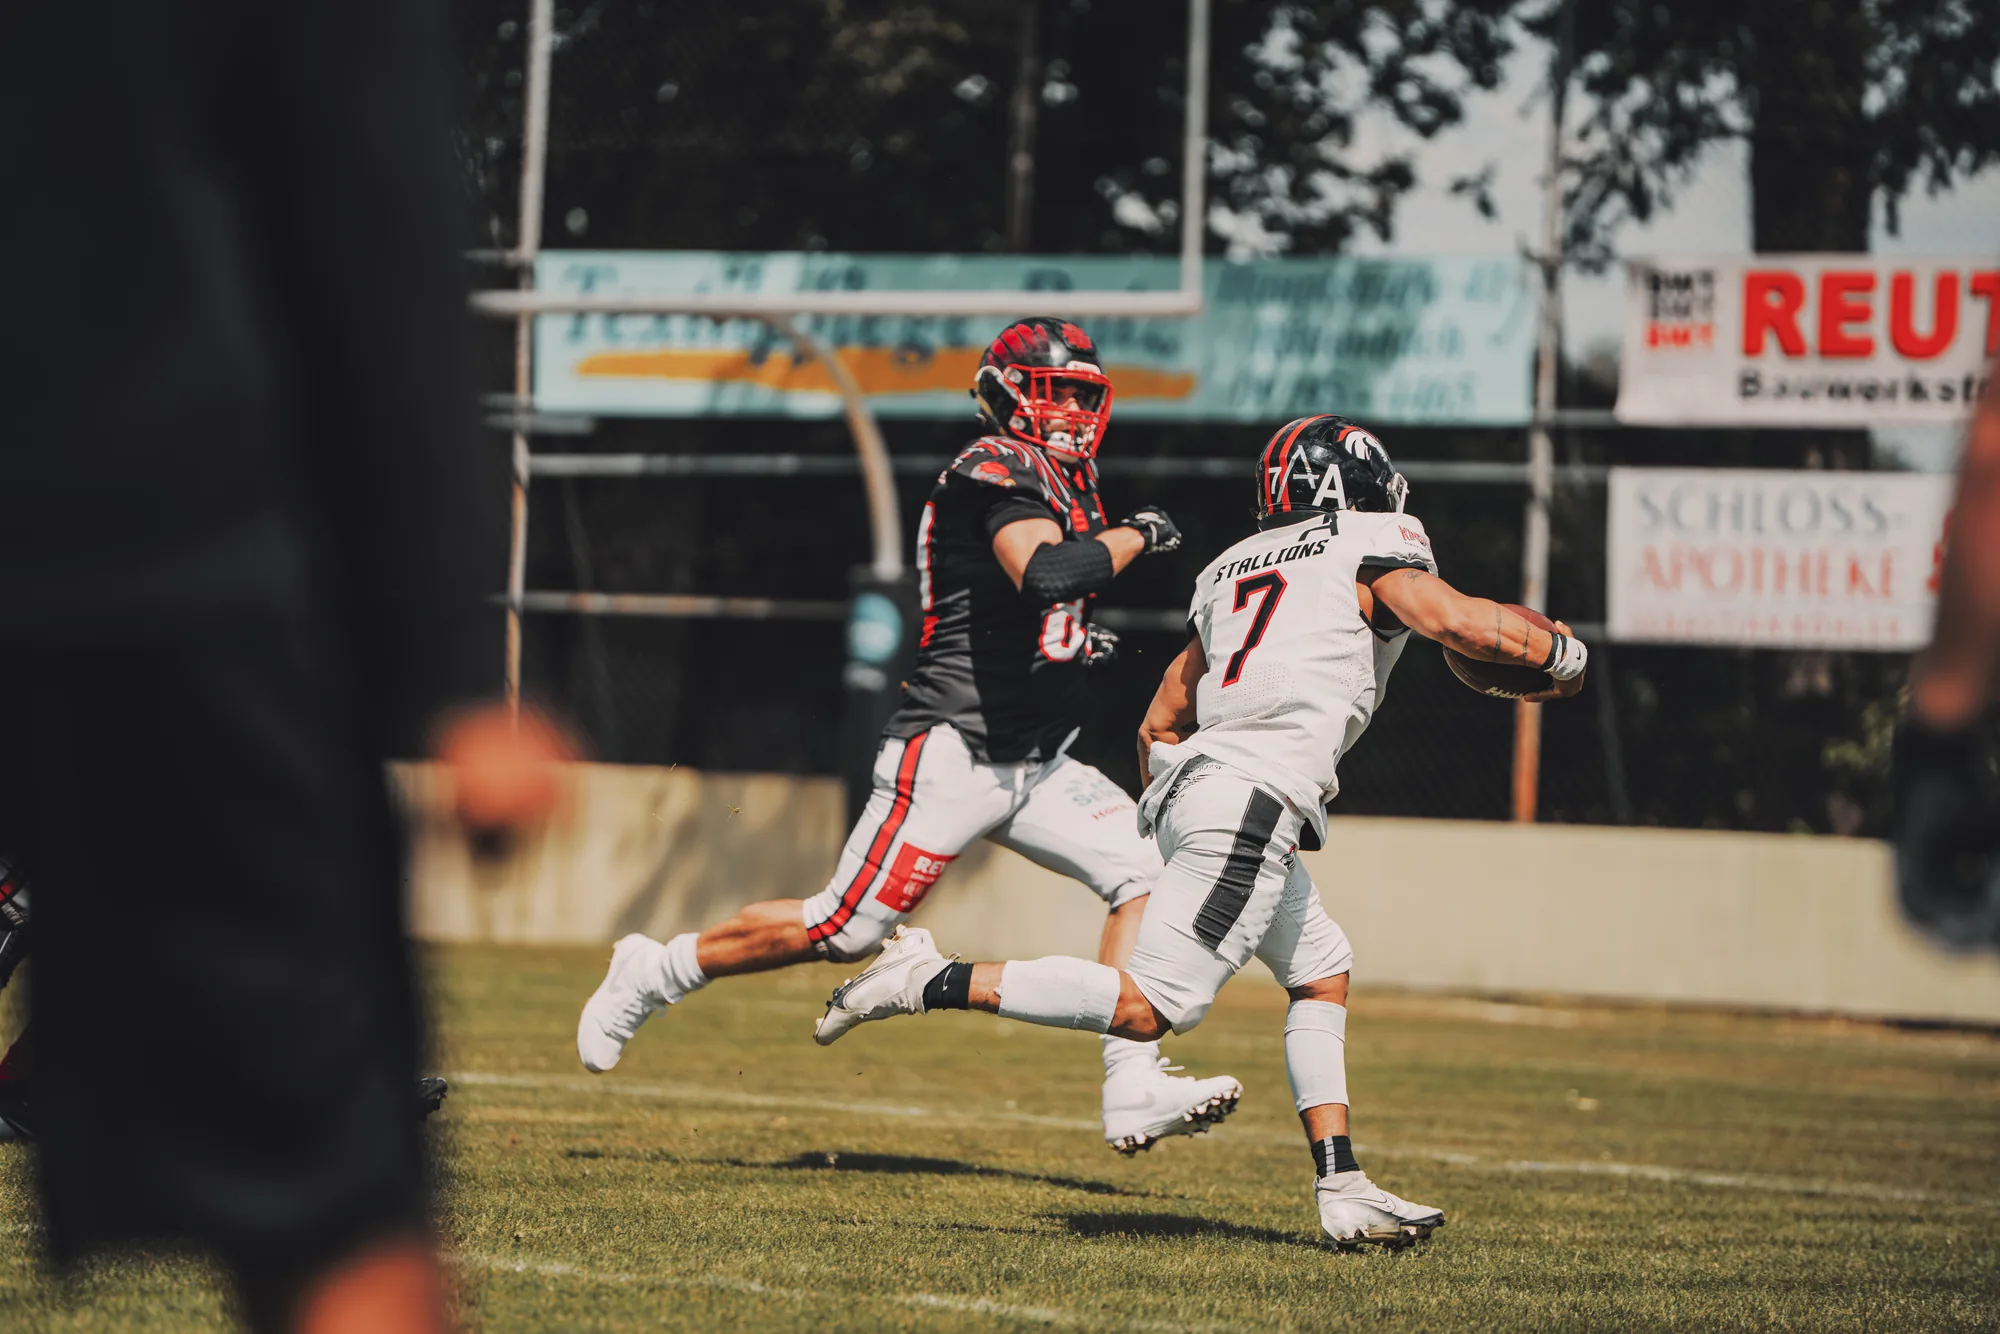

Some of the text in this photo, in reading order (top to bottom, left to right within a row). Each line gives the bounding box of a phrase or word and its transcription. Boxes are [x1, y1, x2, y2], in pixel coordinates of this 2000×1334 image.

[1268, 466, 1282, 494] 7
[1312, 463, 1347, 509] A
[1213, 539, 1329, 586] STALLIONS
[1221, 569, 1288, 689] 7
